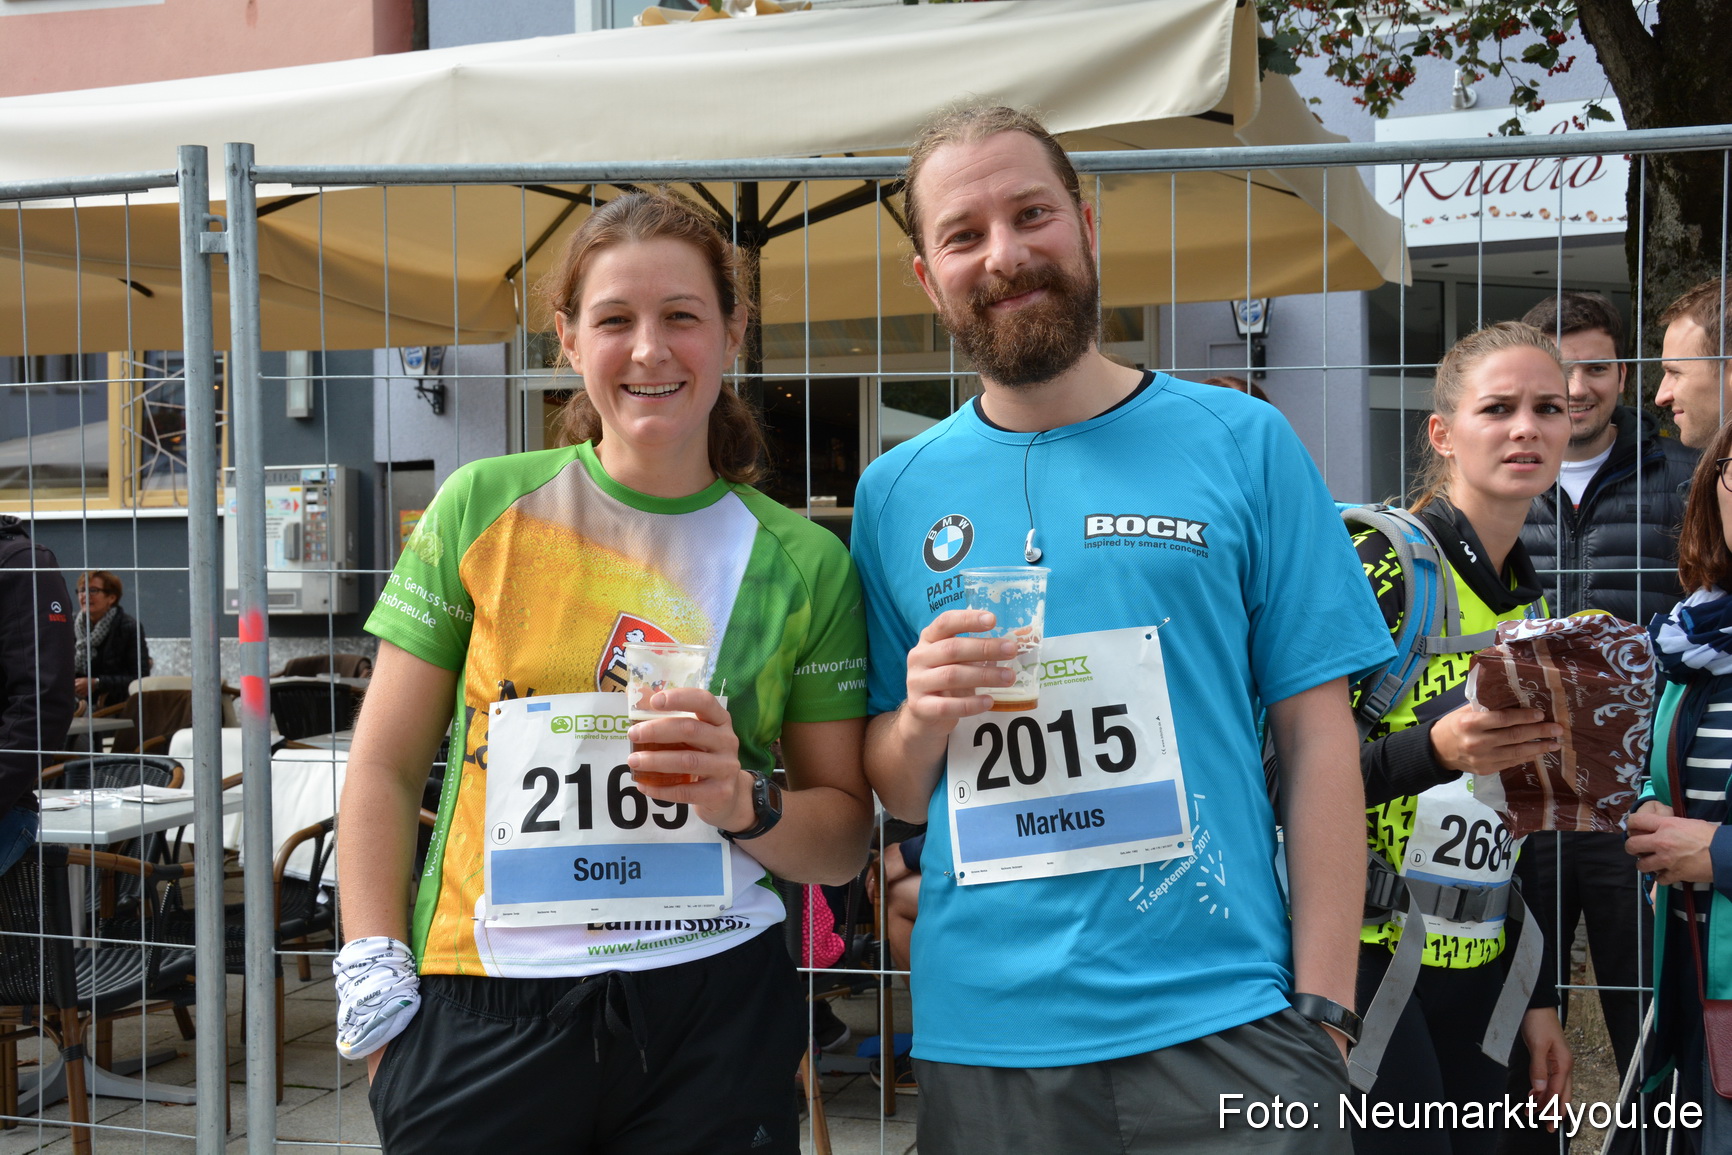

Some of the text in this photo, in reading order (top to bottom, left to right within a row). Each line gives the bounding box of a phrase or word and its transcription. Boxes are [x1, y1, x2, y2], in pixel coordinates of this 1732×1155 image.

[1390, 121, 1608, 205] Rialto
[928, 517, 970, 541] BMW
[1084, 514, 1209, 549] BOCK
[1084, 539, 1209, 559] inspired by smart concepts
[404, 577, 441, 606] Genuss
[442, 601, 474, 622] scha
[926, 574, 964, 602] PART
[929, 590, 965, 613] Neumar
[1043, 675, 1094, 688] smart concepts
[575, 714, 630, 734] BOC
[575, 733, 600, 741] inspired
[601, 733, 608, 741] by
[972, 703, 1137, 791] 2015
[1015, 807, 1106, 837] Markus
[1431, 814, 1513, 872] 2684
[573, 856, 642, 885] Sonja
[1136, 899, 1153, 913] 17.
[1148, 852, 1199, 901] September
[1194, 829, 1211, 855] 2017
